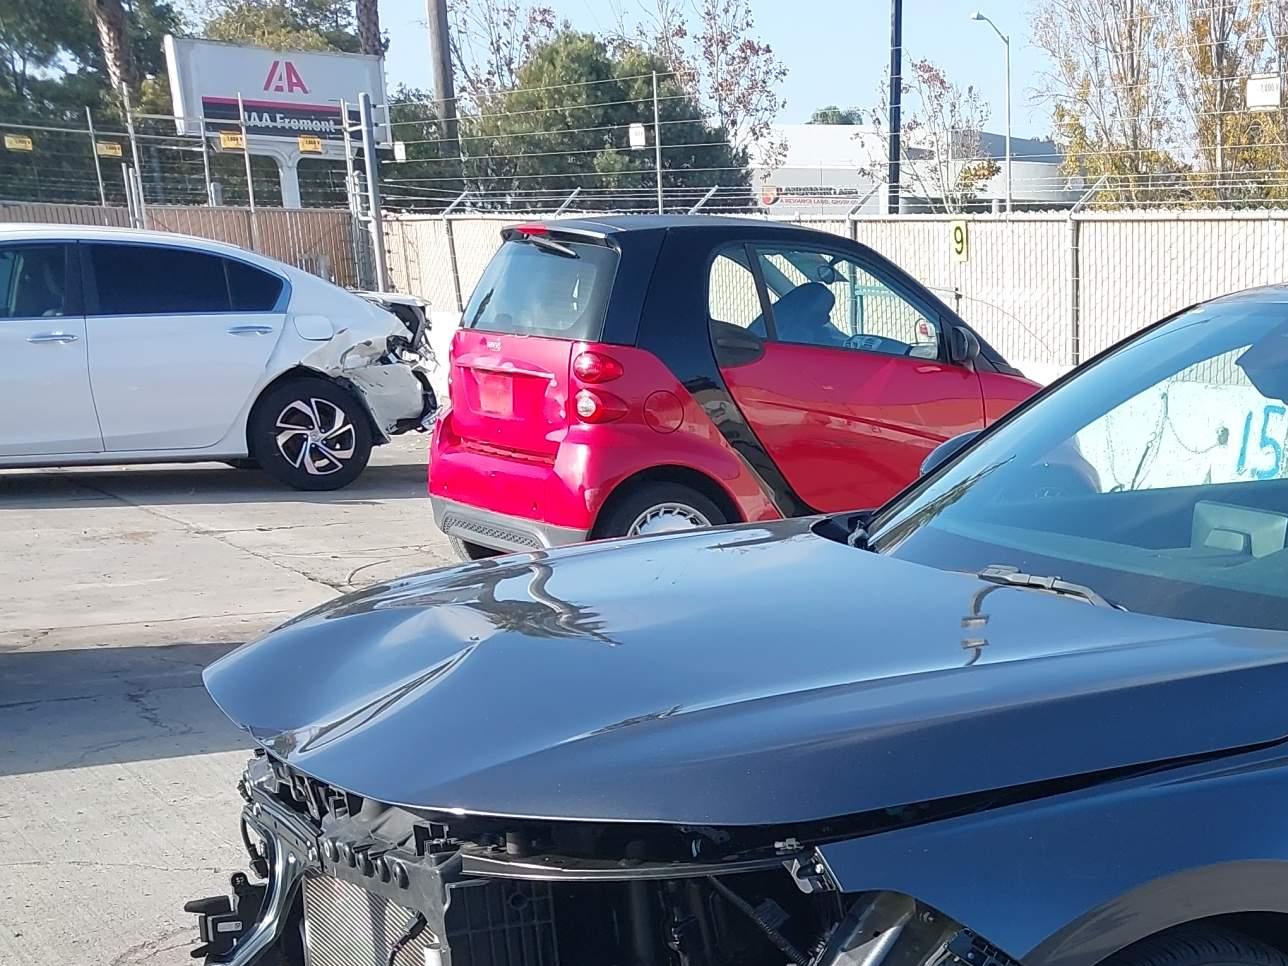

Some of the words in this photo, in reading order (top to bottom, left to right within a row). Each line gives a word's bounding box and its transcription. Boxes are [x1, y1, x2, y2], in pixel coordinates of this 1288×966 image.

[244, 112, 271, 129] IAA
[276, 113, 336, 133] Fremont
[953, 225, 965, 255] 9
[1237, 405, 1286, 480] 15
